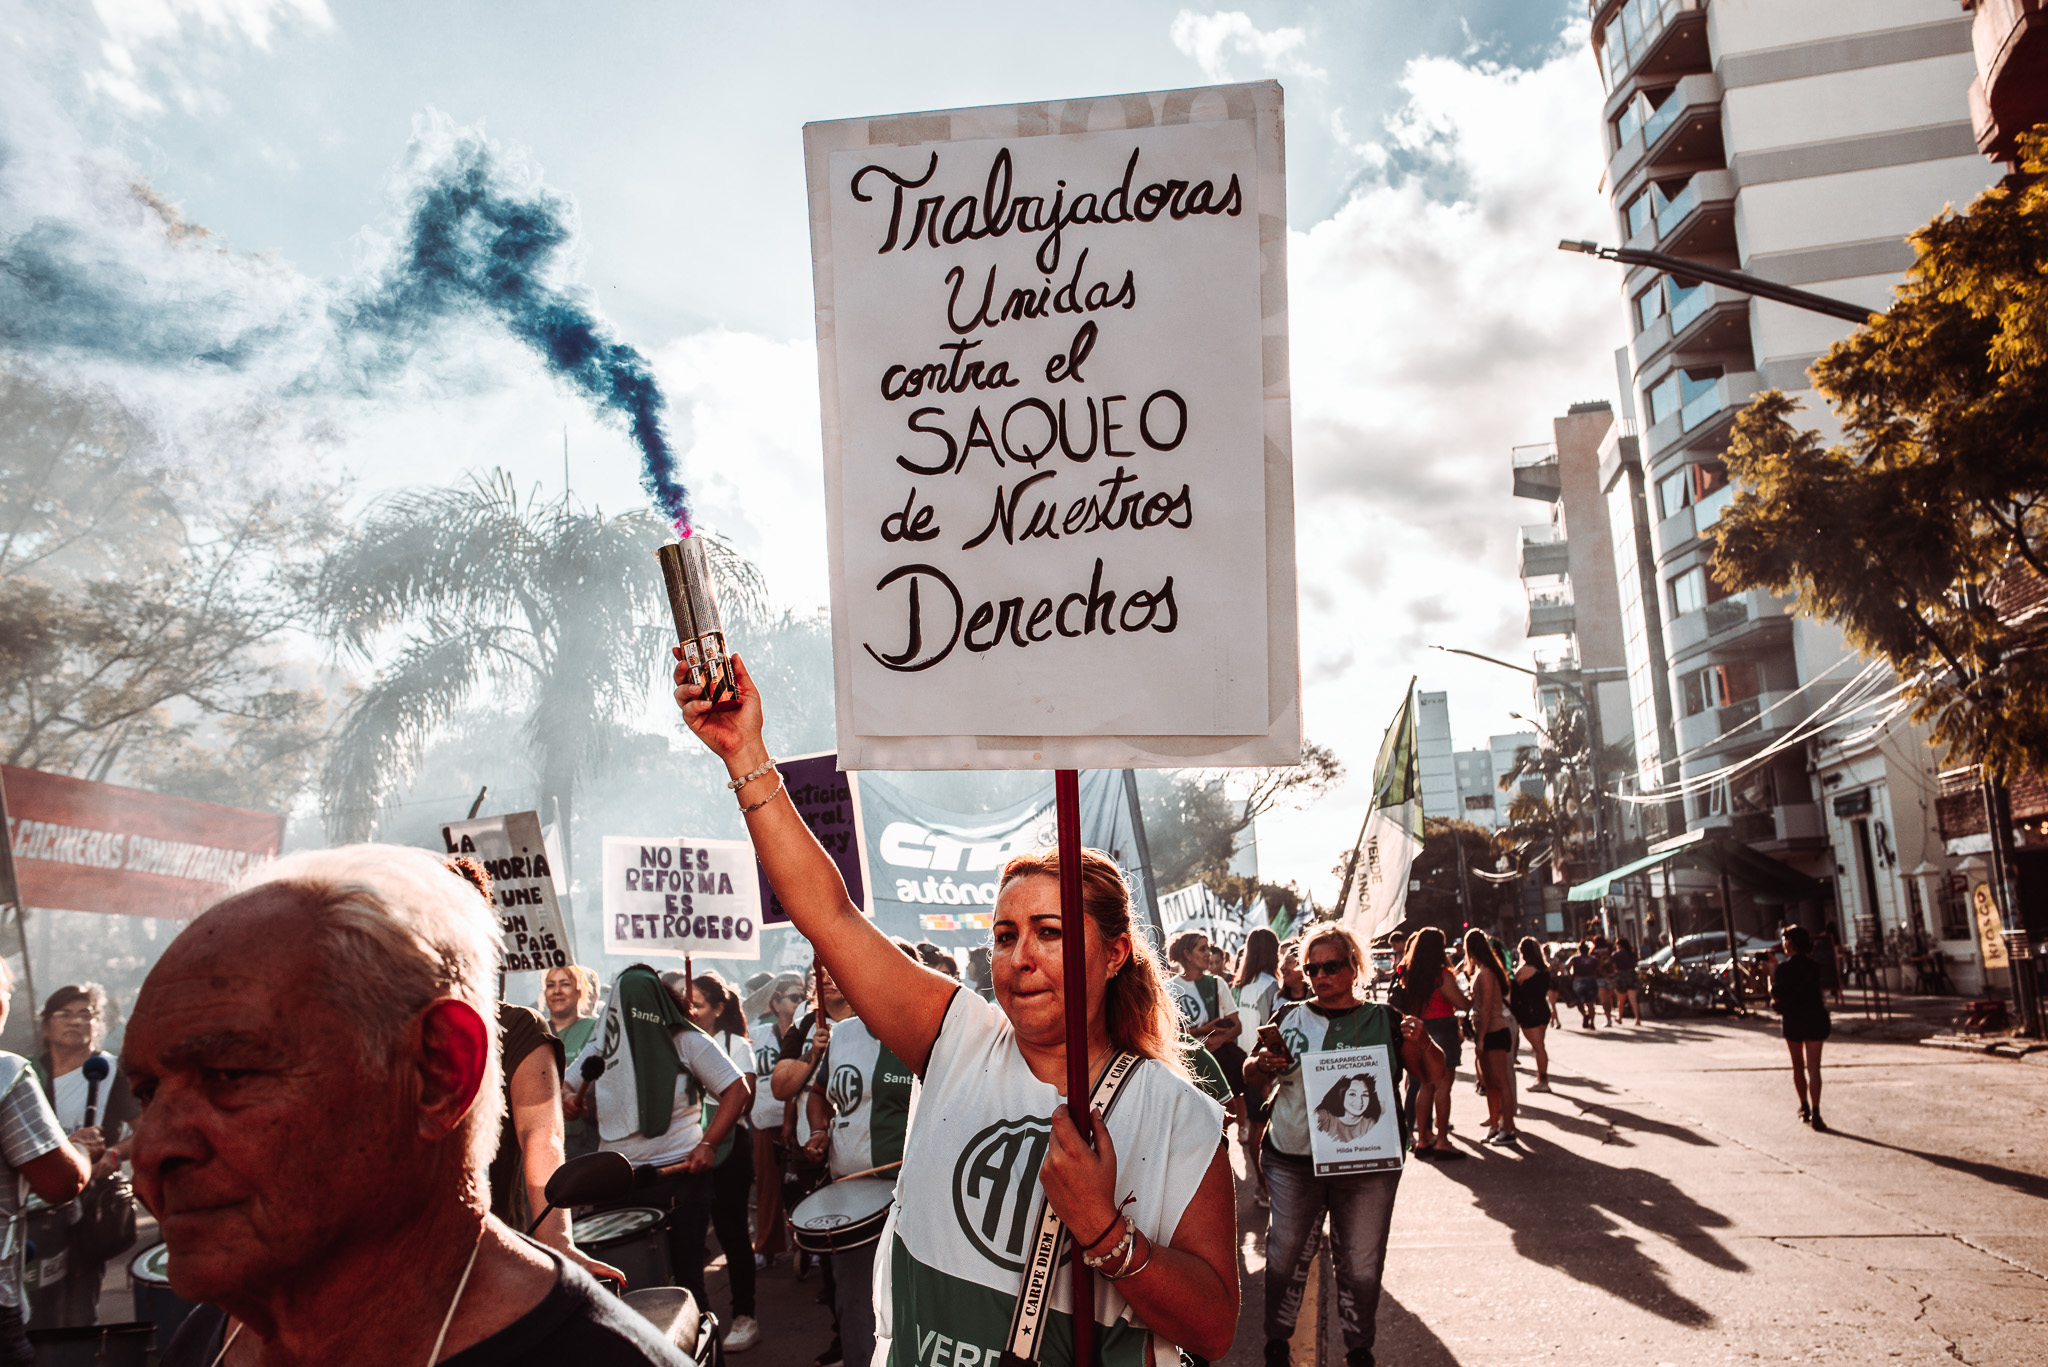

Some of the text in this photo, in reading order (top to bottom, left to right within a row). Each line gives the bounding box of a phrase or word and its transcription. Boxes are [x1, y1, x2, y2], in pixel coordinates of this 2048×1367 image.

[851, 146, 1242, 274] Trabajadoras
[945, 248, 1136, 335] Unidas
[881, 320, 1098, 401] contra el
[896, 389, 1188, 475] SAQUEO
[880, 466, 1193, 550] de Nuestros
[863, 558, 1178, 672] Derechos
[791, 784, 852, 806] sticia
[13, 819, 125, 870] COCINERAS
[124, 834, 246, 884] COMUNITARIAS
[442, 826, 476, 853] LA
[484, 847, 551, 881] MORIA
[640, 846, 709, 871] NO ES
[1367, 834, 1382, 884] VERDE
[501, 887, 543, 907] UNE
[625, 867, 734, 895] REFORMA
[665, 894, 694, 916] ES
[896, 876, 1000, 905] autóno
[614, 913, 753, 941] RETROCESO
[1977, 891, 2001, 960] KIOSCO
[631, 1007, 660, 1023] Santa
[1025, 1231, 1055, 1317] CARPE DIEM
